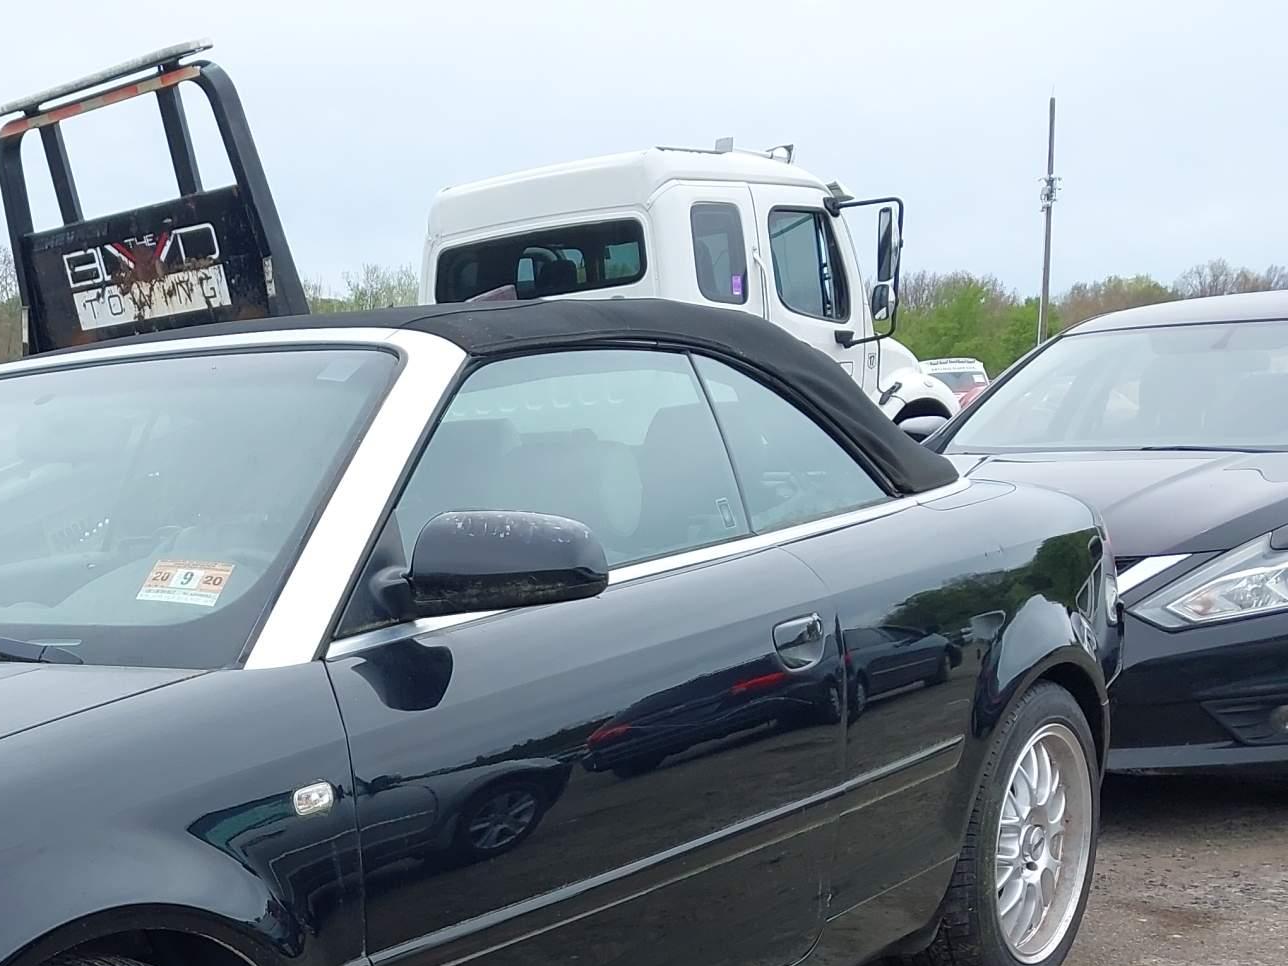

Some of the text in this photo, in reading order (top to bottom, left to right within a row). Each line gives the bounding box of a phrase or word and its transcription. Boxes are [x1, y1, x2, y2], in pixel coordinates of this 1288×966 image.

[83, 272, 218, 320] TOWING
[152, 571, 222, 586] 20 9 20
